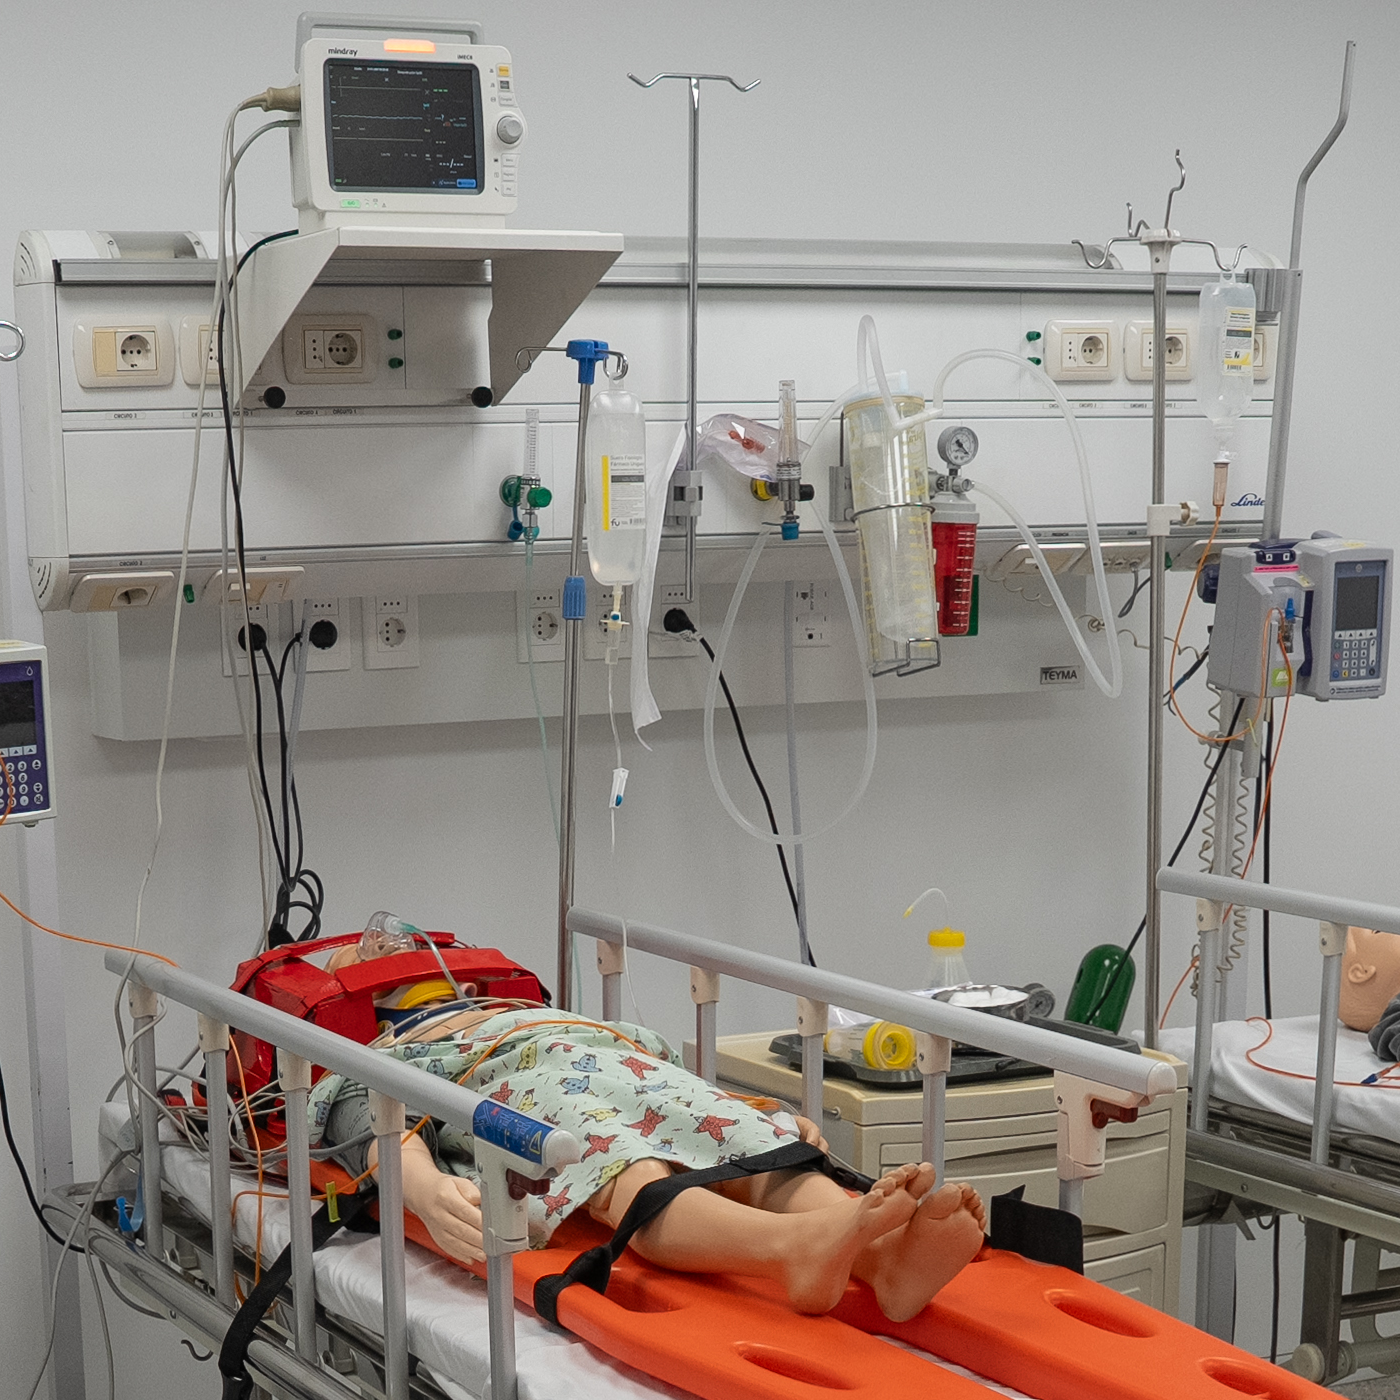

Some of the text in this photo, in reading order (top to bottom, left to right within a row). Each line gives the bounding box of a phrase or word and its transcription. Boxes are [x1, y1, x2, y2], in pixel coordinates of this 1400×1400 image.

[328, 47, 358, 57] mindray
[1230, 493, 1265, 507] Linde
[1042, 670, 1078, 681] TEYMA
